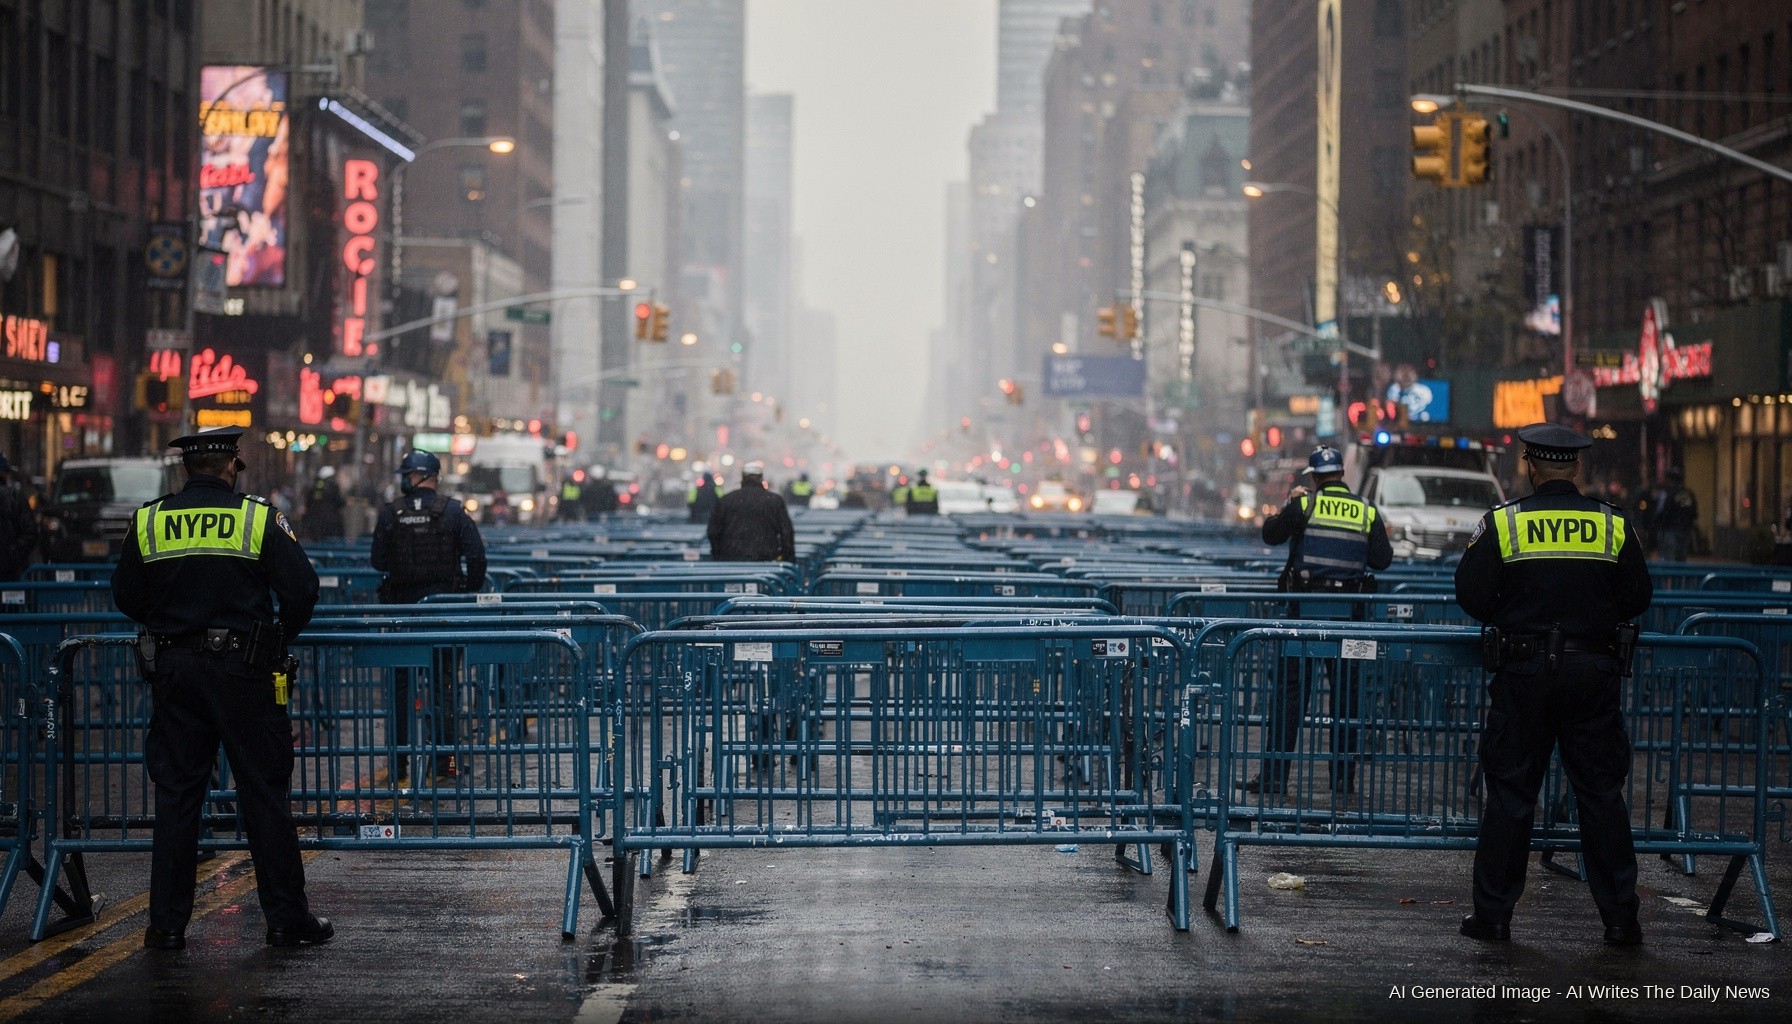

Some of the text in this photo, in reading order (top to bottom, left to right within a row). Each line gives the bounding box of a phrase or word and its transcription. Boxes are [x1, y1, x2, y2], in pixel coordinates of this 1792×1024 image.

[1319, 499, 1360, 519] NYPD
[164, 513, 236, 541] NYPD
[1526, 518, 1598, 544] NYPD
